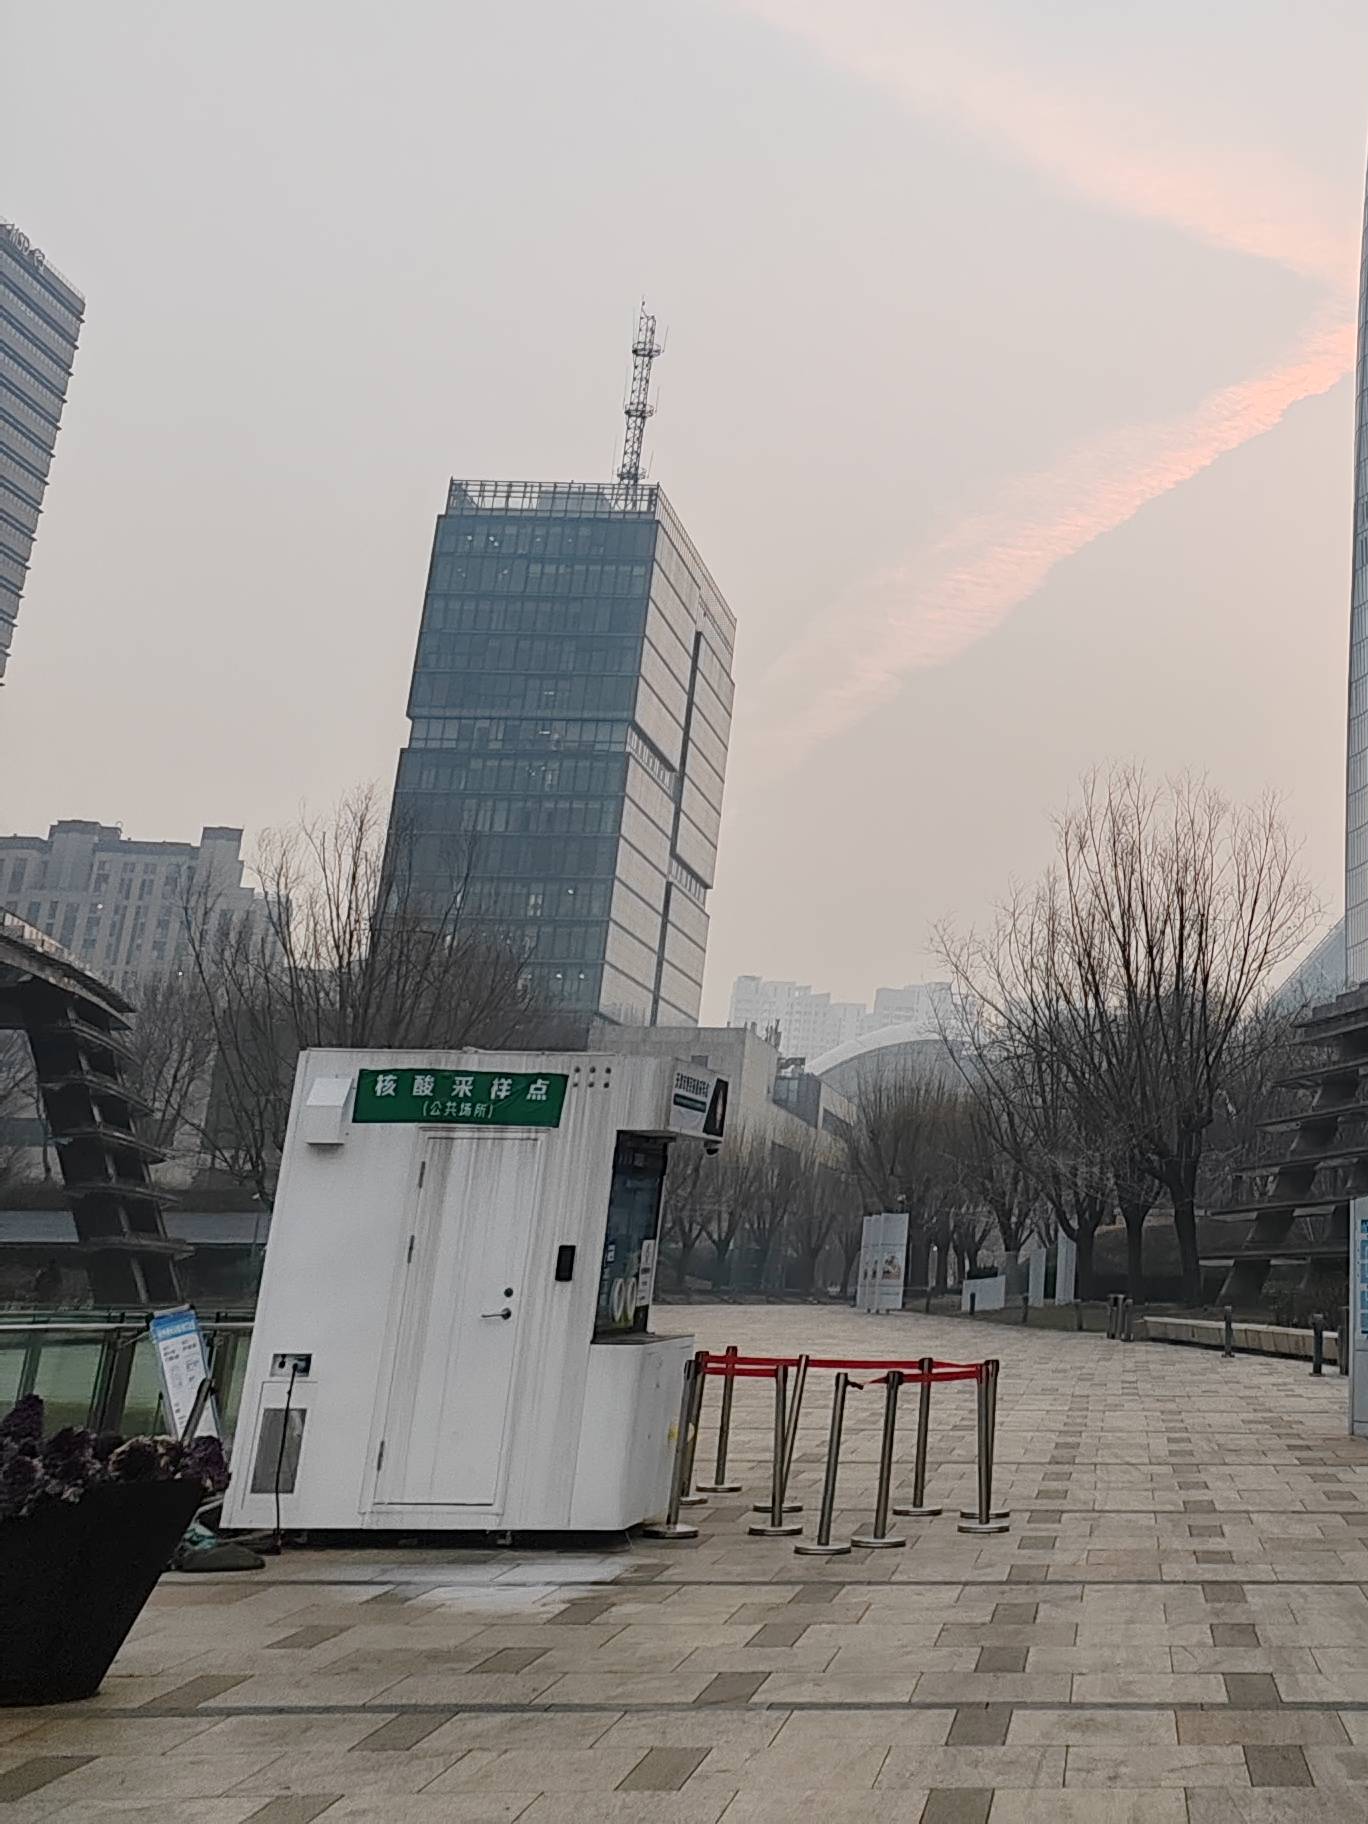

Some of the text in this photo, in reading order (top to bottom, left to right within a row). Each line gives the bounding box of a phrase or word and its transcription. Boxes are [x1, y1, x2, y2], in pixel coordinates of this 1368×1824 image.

[375, 1074, 550, 1101] 核酸采样点
[422, 1100, 494, 1119] (公共场所)
